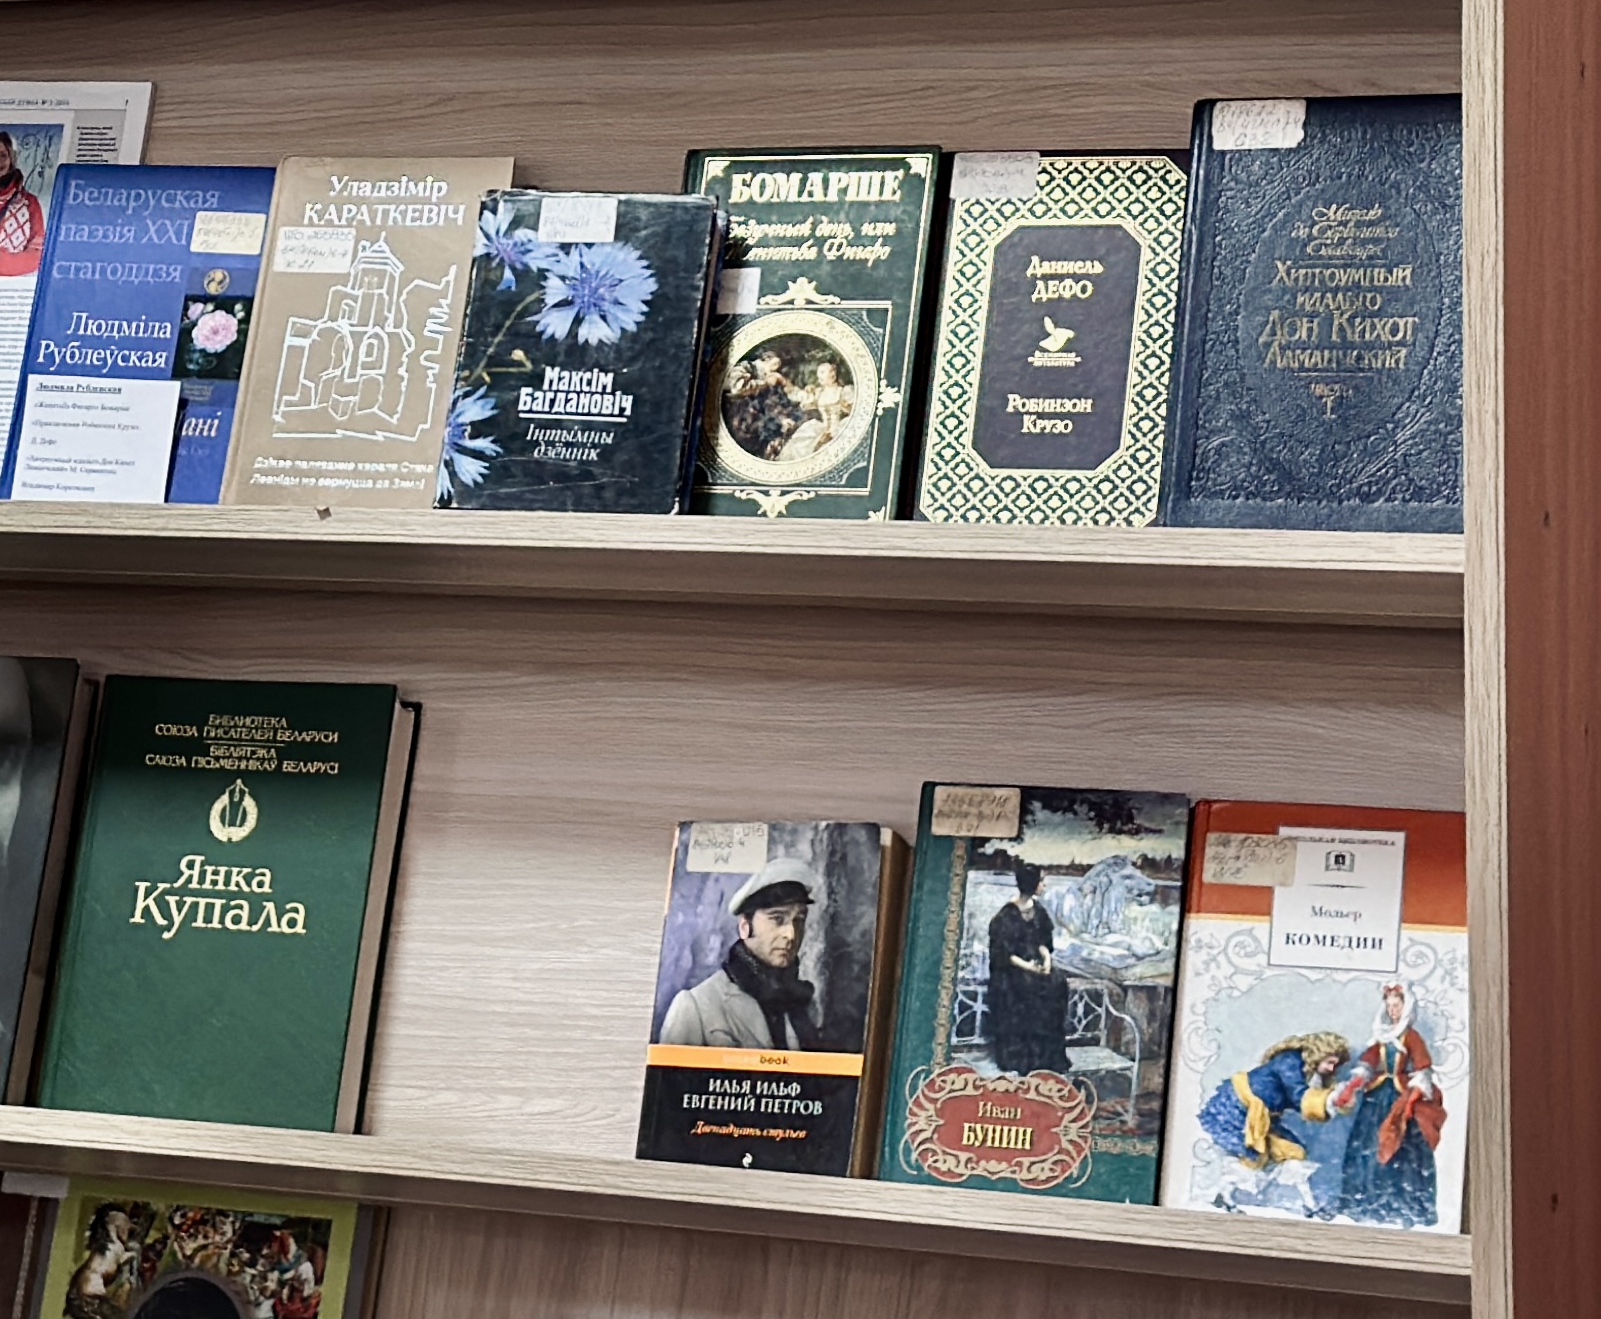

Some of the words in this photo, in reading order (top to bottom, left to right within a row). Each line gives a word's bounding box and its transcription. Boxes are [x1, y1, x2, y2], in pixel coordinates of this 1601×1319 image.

[67, 179, 220, 211] Беларуская
[329, 174, 449, 200] Уладзімір
[728, 170, 906, 204] БОМАРШЕ
[303, 202, 466, 227] КАРАТКЕВІЧ
[57, 214, 136, 247] паэзія
[142, 218, 188, 247] XXI
[860, 221, 897, 237] или
[823, 237, 892, 268] Фигаро
[51, 259, 183, 285] стагоддзя
[1026, 255, 1105, 277] Даниель
[1031, 278, 1094, 302] ДЕФО
[67, 312, 172, 341] Людміла
[1258, 309, 1319, 348] ДОН
[1330, 309, 1419, 345] КИХОТ
[37, 338, 168, 370] Рублеўская
[542, 366, 615, 393] Максім
[518, 387, 634, 416] Багдановіч
[1006, 393, 1094, 413] РОБИНЗОН
[526, 423, 615, 446] Інтымны
[1021, 414, 1074, 434] КРУЗО
[533, 440, 602, 461] дзённік
[155, 723, 198, 737] СОЮЗА
[203, 726, 274, 740] ПИСАТЕЛЕЙ
[277, 729, 339, 743] БЕЛАРУСИ
[208, 714, 288, 729] БИБЛИОТЕКА
[145, 753, 187, 767] САЮЗА
[191, 758, 278, 772] ПІСЬМЕННІКАЎ
[282, 760, 339, 774] БЕЛАРУСІ
[209, 744, 277, 759] БІБЛІЯТЭКА
[173, 854, 274, 893] Янка
[129, 880, 307, 940] Купала
[1309, 905, 1362, 923] Мольер
[1284, 932, 1385, 951] КОМЕДИИ
[708, 1078, 752, 1095] ИЛЬЯ
[755, 1080, 801, 1098] ИЛЬФ
[682, 1093, 756, 1113] ЕВГЕНИЙ
[760, 1097, 824, 1116] ПЕТРОВ
[978, 1101, 1022, 1119] Иван
[961, 1122, 1033, 1151] БУНИН
